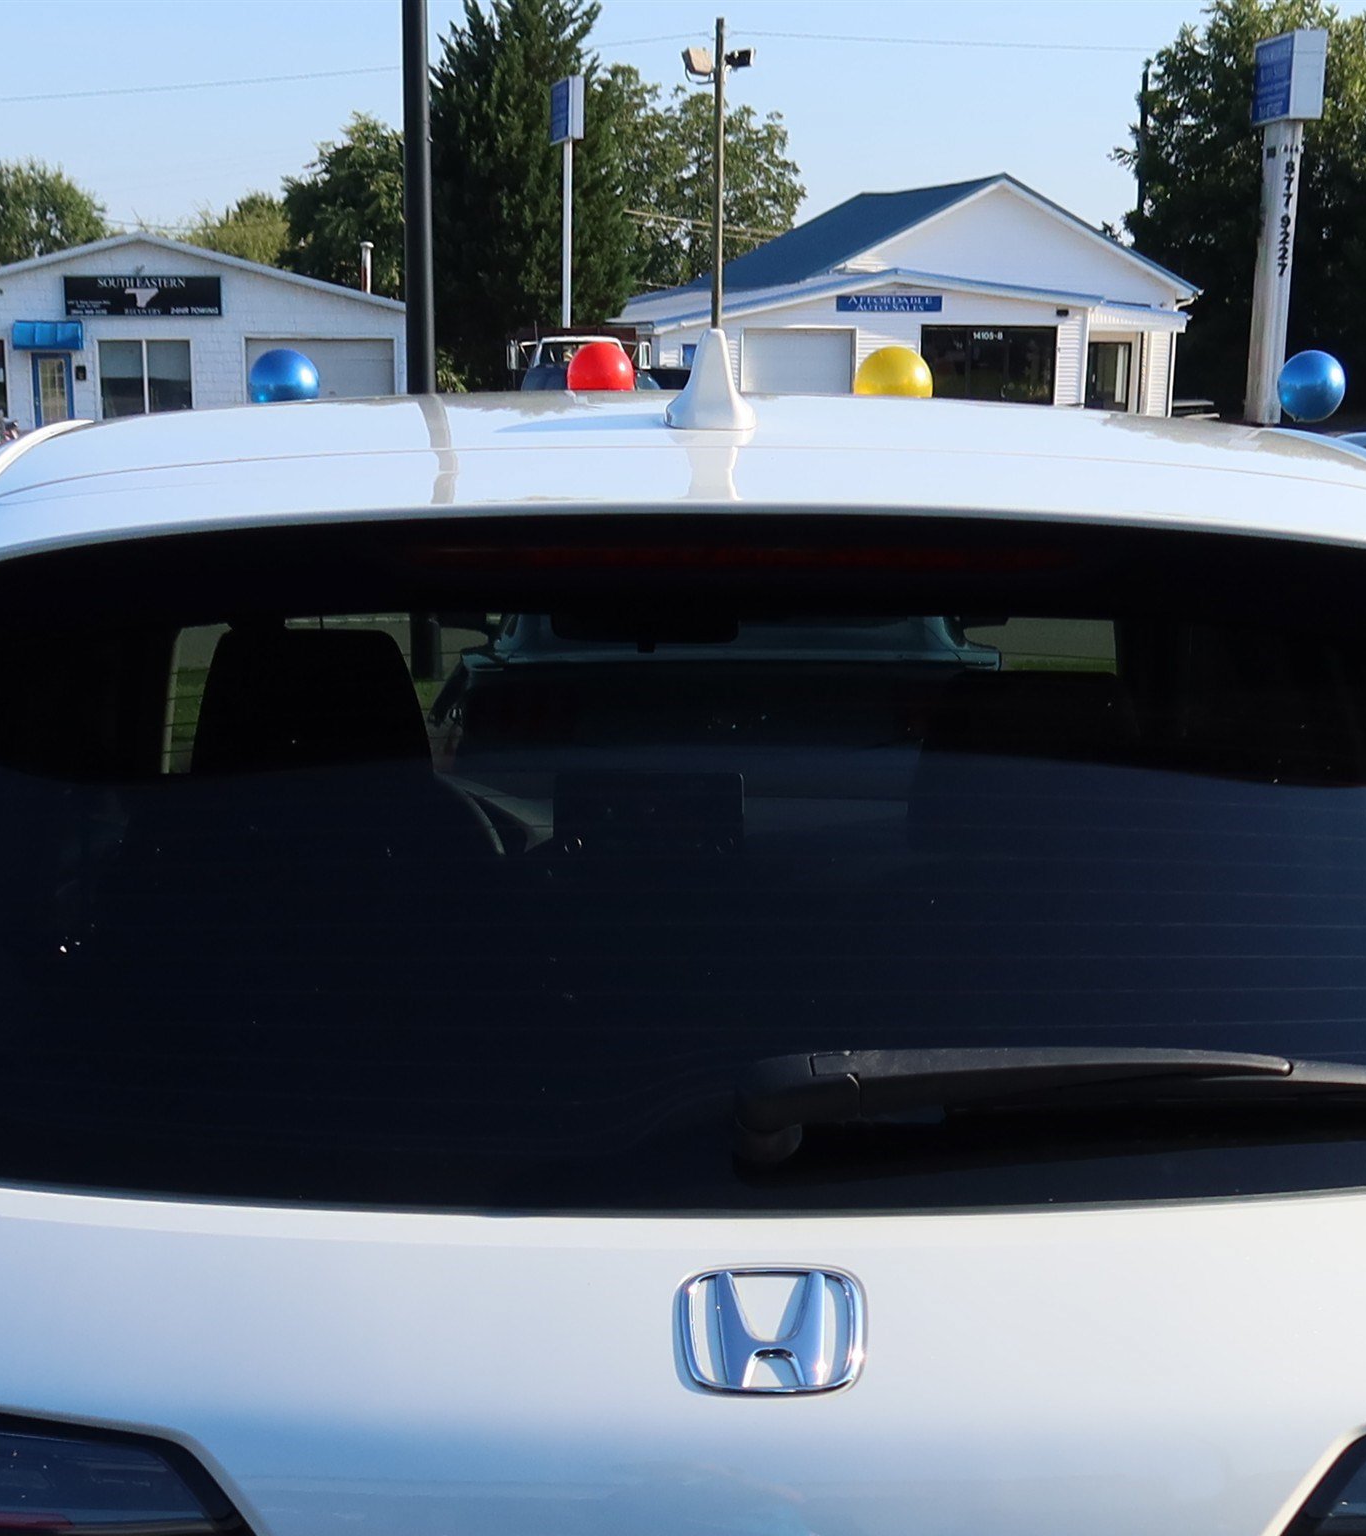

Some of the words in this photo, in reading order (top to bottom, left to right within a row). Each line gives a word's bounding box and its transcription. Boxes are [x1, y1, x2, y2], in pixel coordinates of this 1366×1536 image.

[1283, 161, 1295, 207] 877
[1277, 214, 1291, 276] 9227
[136, 277, 186, 289] EASTERN
